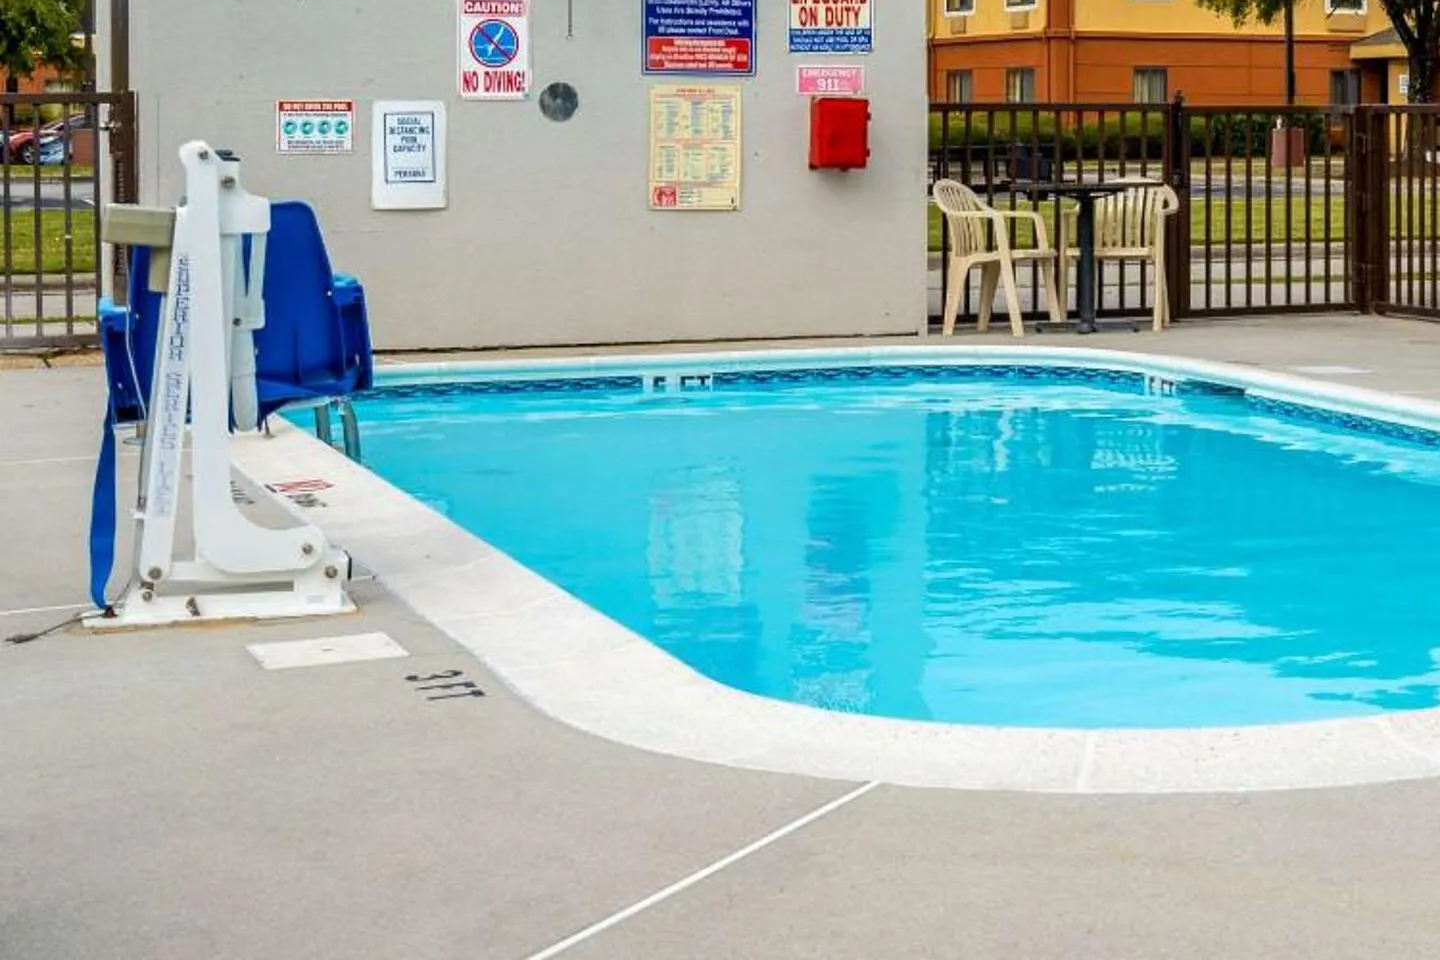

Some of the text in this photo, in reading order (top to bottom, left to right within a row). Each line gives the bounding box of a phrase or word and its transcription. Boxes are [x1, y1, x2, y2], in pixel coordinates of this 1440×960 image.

[798, 5, 862, 27] ON DUTY
[462, 70, 525, 93] NO DIVING!
